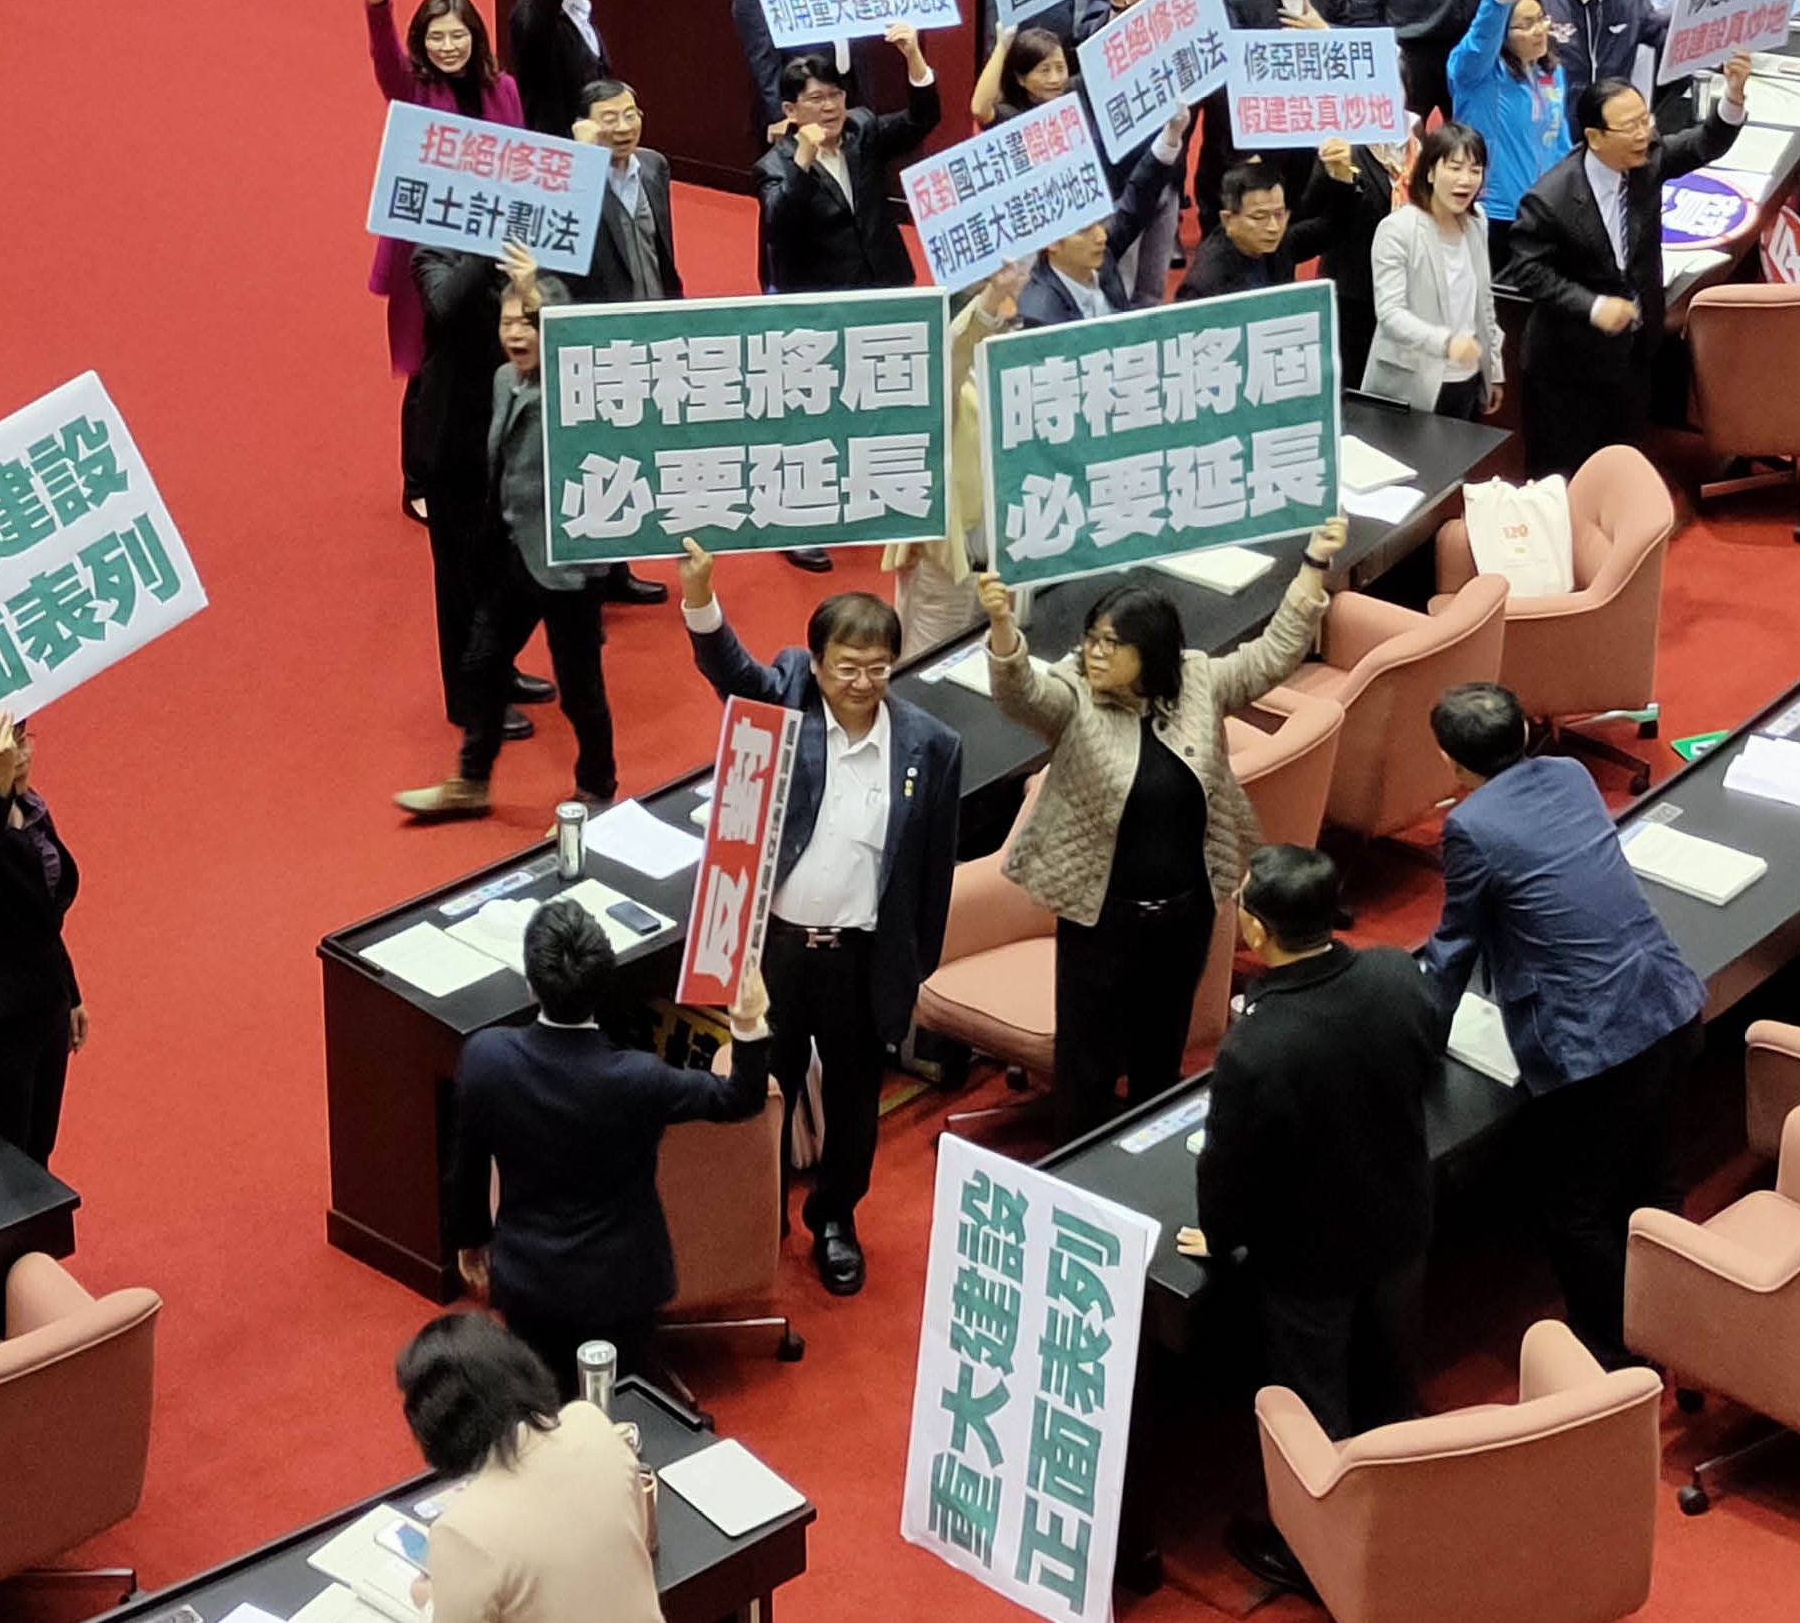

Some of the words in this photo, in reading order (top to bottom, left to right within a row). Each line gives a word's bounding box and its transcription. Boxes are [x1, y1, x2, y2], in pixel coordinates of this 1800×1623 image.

[1106, 30, 1229, 141] 國土計劃法
[1236, 95, 1396, 134] 假建設真炒地
[1243, 41, 1376, 83] 修惡開後門
[420, 122, 574, 192] 拒絕修惡
[910, 102, 1086, 221] 反對國土計畫開後門
[388, 176, 580, 255] 國土計劃法
[929, 163, 1105, 277] 利用重大建設炒地皮
[557, 322, 930, 428] 時程將屆
[1002, 311, 1322, 448] 時程將屆
[561, 433, 933, 539] 必要延長
[1006, 422, 1326, 562] 必要延長
[695, 716, 774, 987] 反對
[929, 1168, 1029, 1568] 重大建設
[1014, 1206, 1122, 1615] 正面表列
